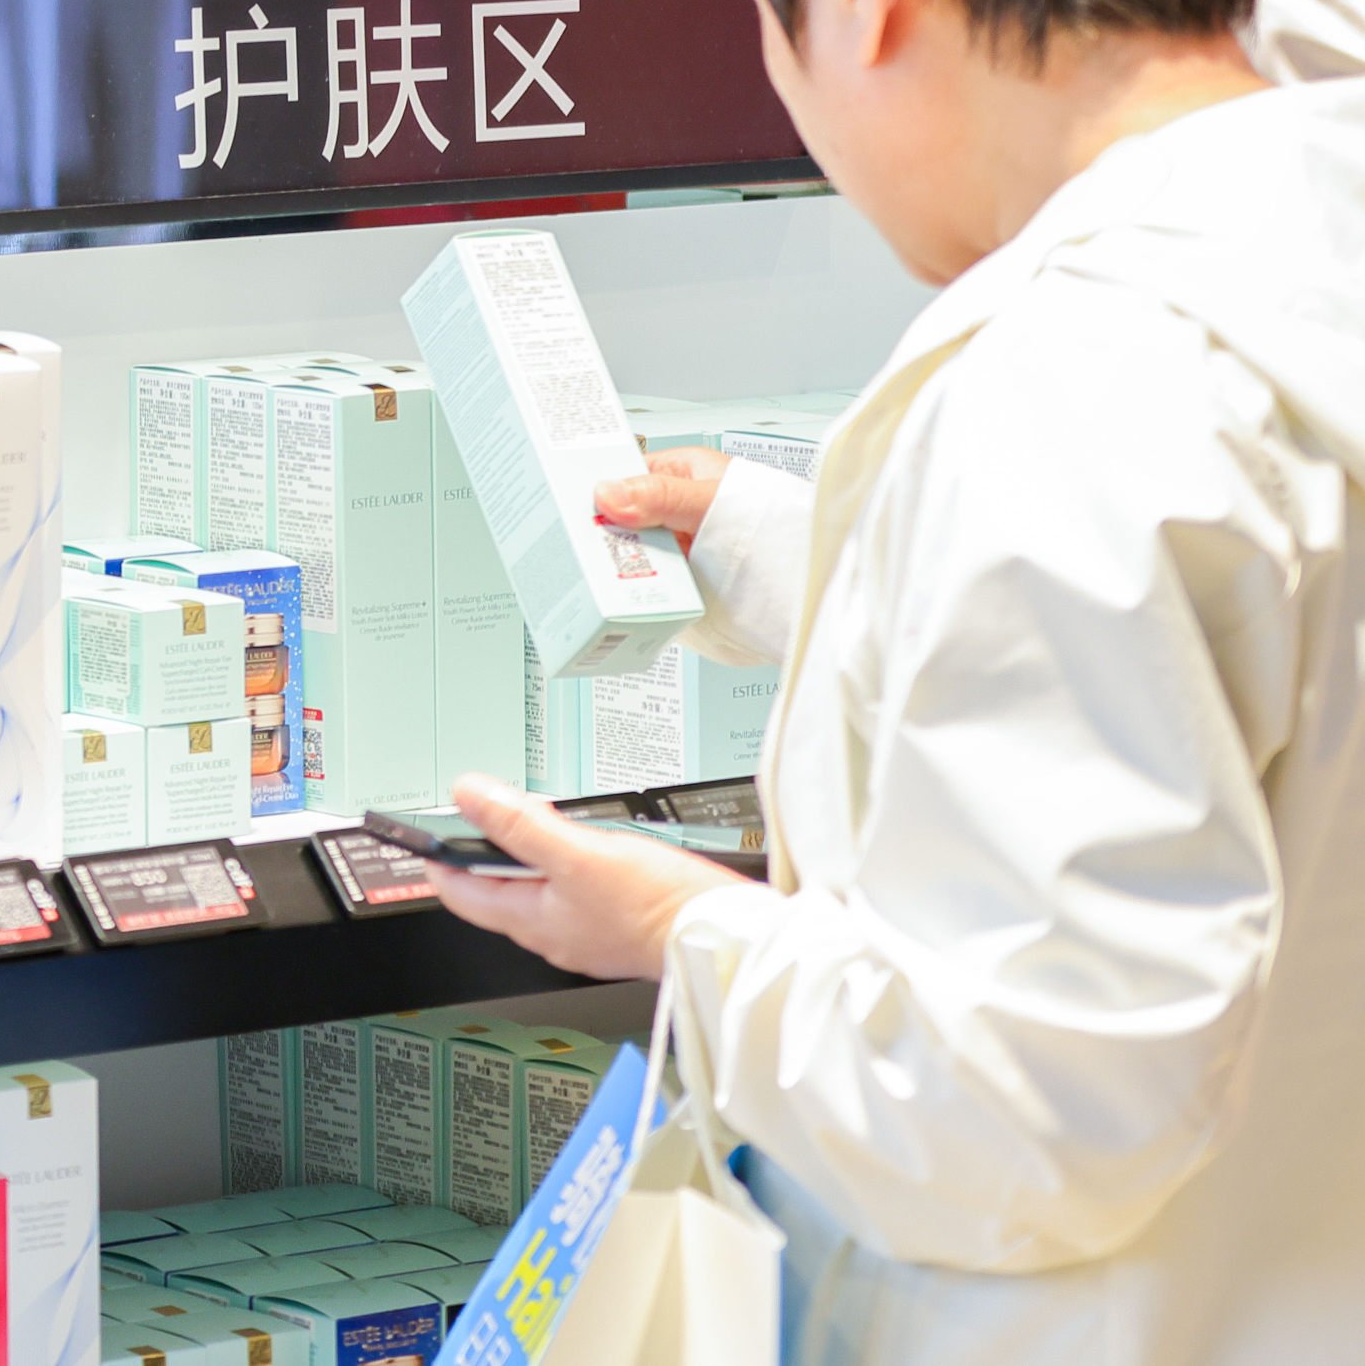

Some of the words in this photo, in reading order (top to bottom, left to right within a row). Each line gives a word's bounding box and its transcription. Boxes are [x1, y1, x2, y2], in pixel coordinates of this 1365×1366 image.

[352, 497, 380, 510] ESTÉE
[383, 492, 423, 506] LAUDER
[732, 683, 764, 699] ESTÉE
